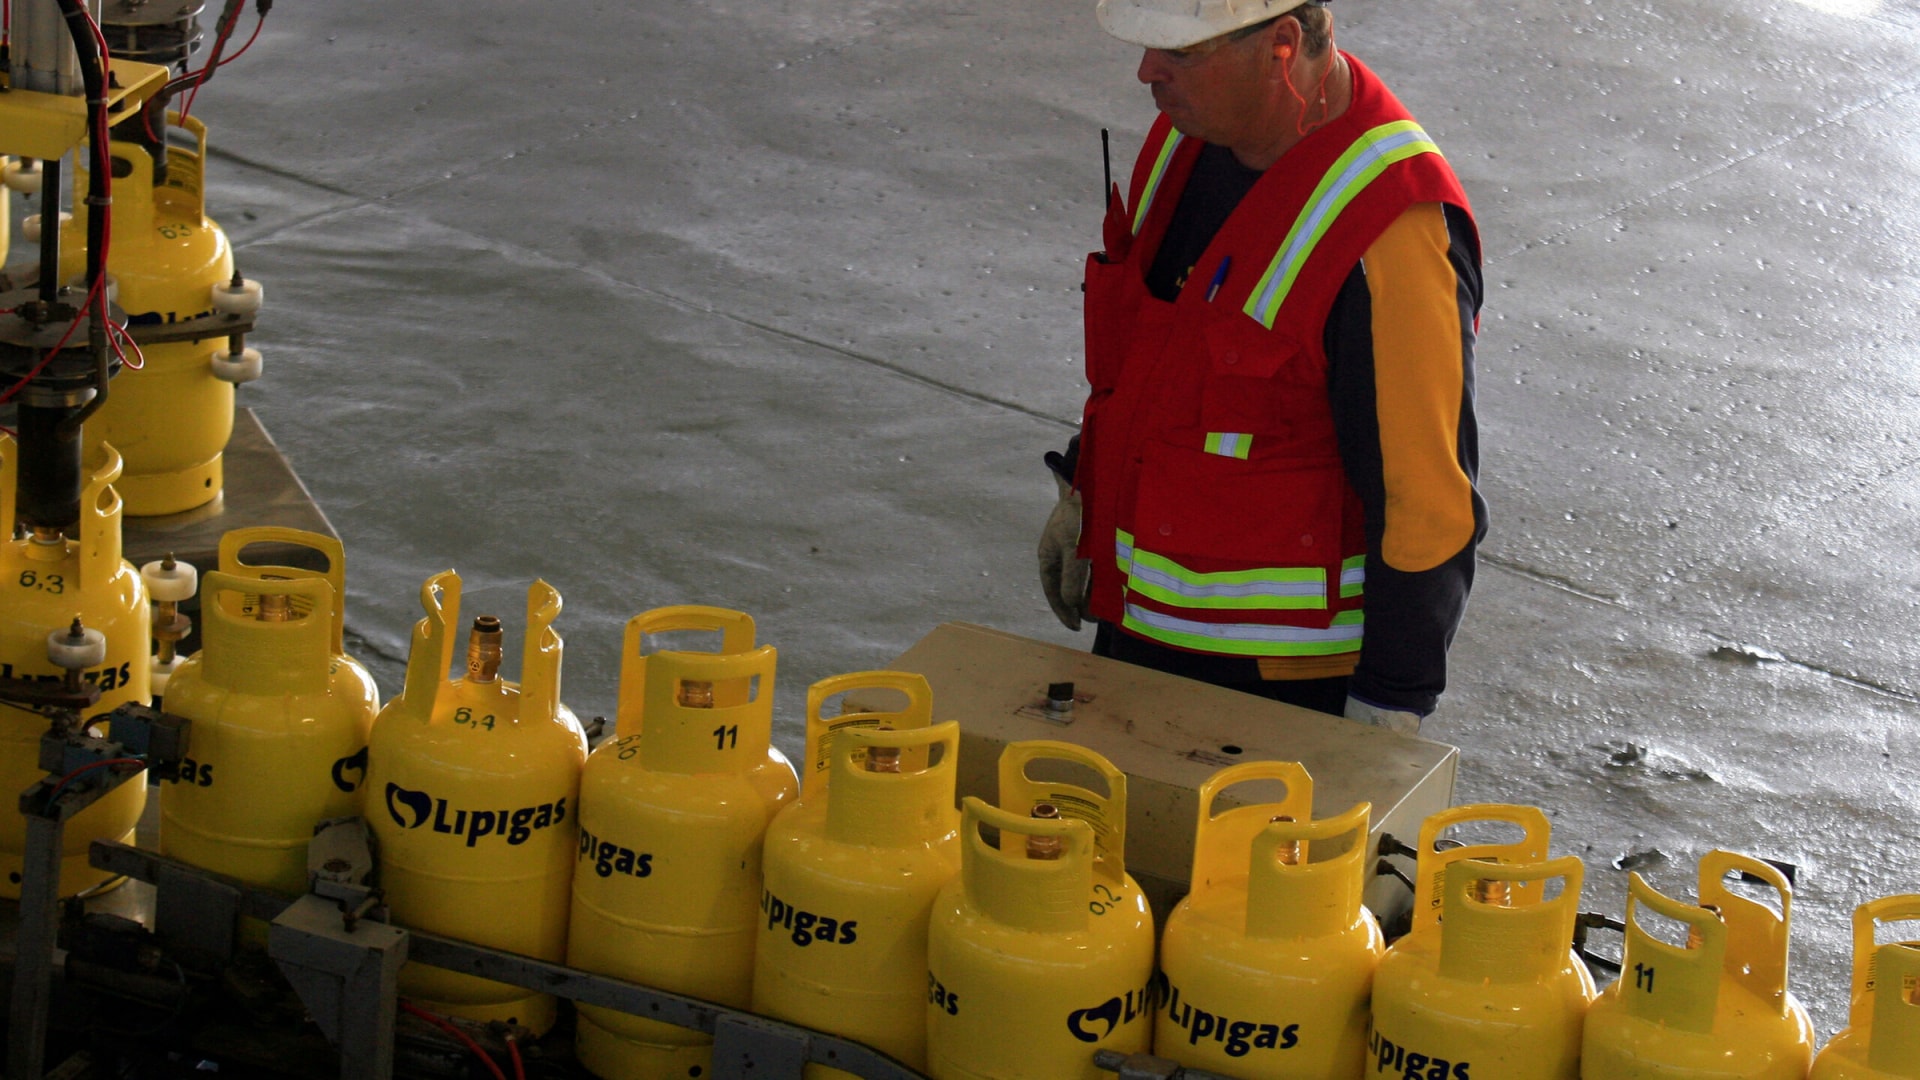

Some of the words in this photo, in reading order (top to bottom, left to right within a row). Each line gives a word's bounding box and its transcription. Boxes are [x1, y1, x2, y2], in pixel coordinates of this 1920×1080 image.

[19, 569, 65, 594] 6,3
[453, 706, 497, 731] 6,4
[712, 724, 739, 750] 11
[432, 796, 567, 848] Lipigas
[1633, 961, 1656, 993] 11
[1168, 983, 1301, 1058] Lipigas
